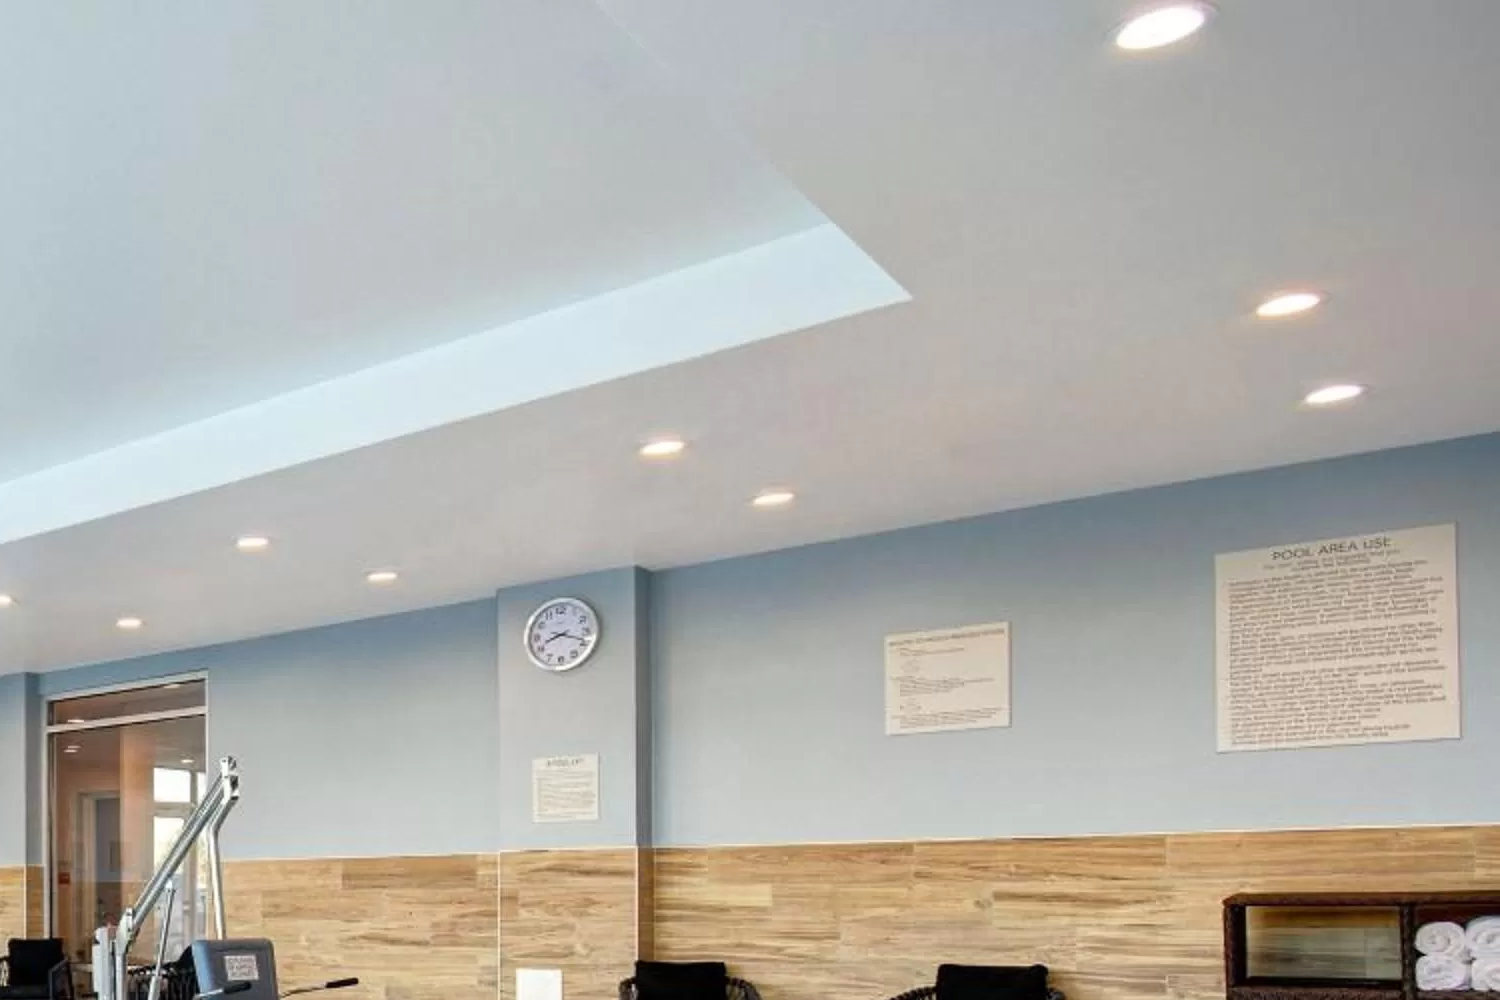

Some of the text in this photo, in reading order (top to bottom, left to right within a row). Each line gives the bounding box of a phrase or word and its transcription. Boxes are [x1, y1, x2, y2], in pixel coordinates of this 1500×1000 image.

[1272, 549, 1315, 561] POOL
[1318, 541, 1358, 556] AREA
[1363, 535, 1391, 550] USE
